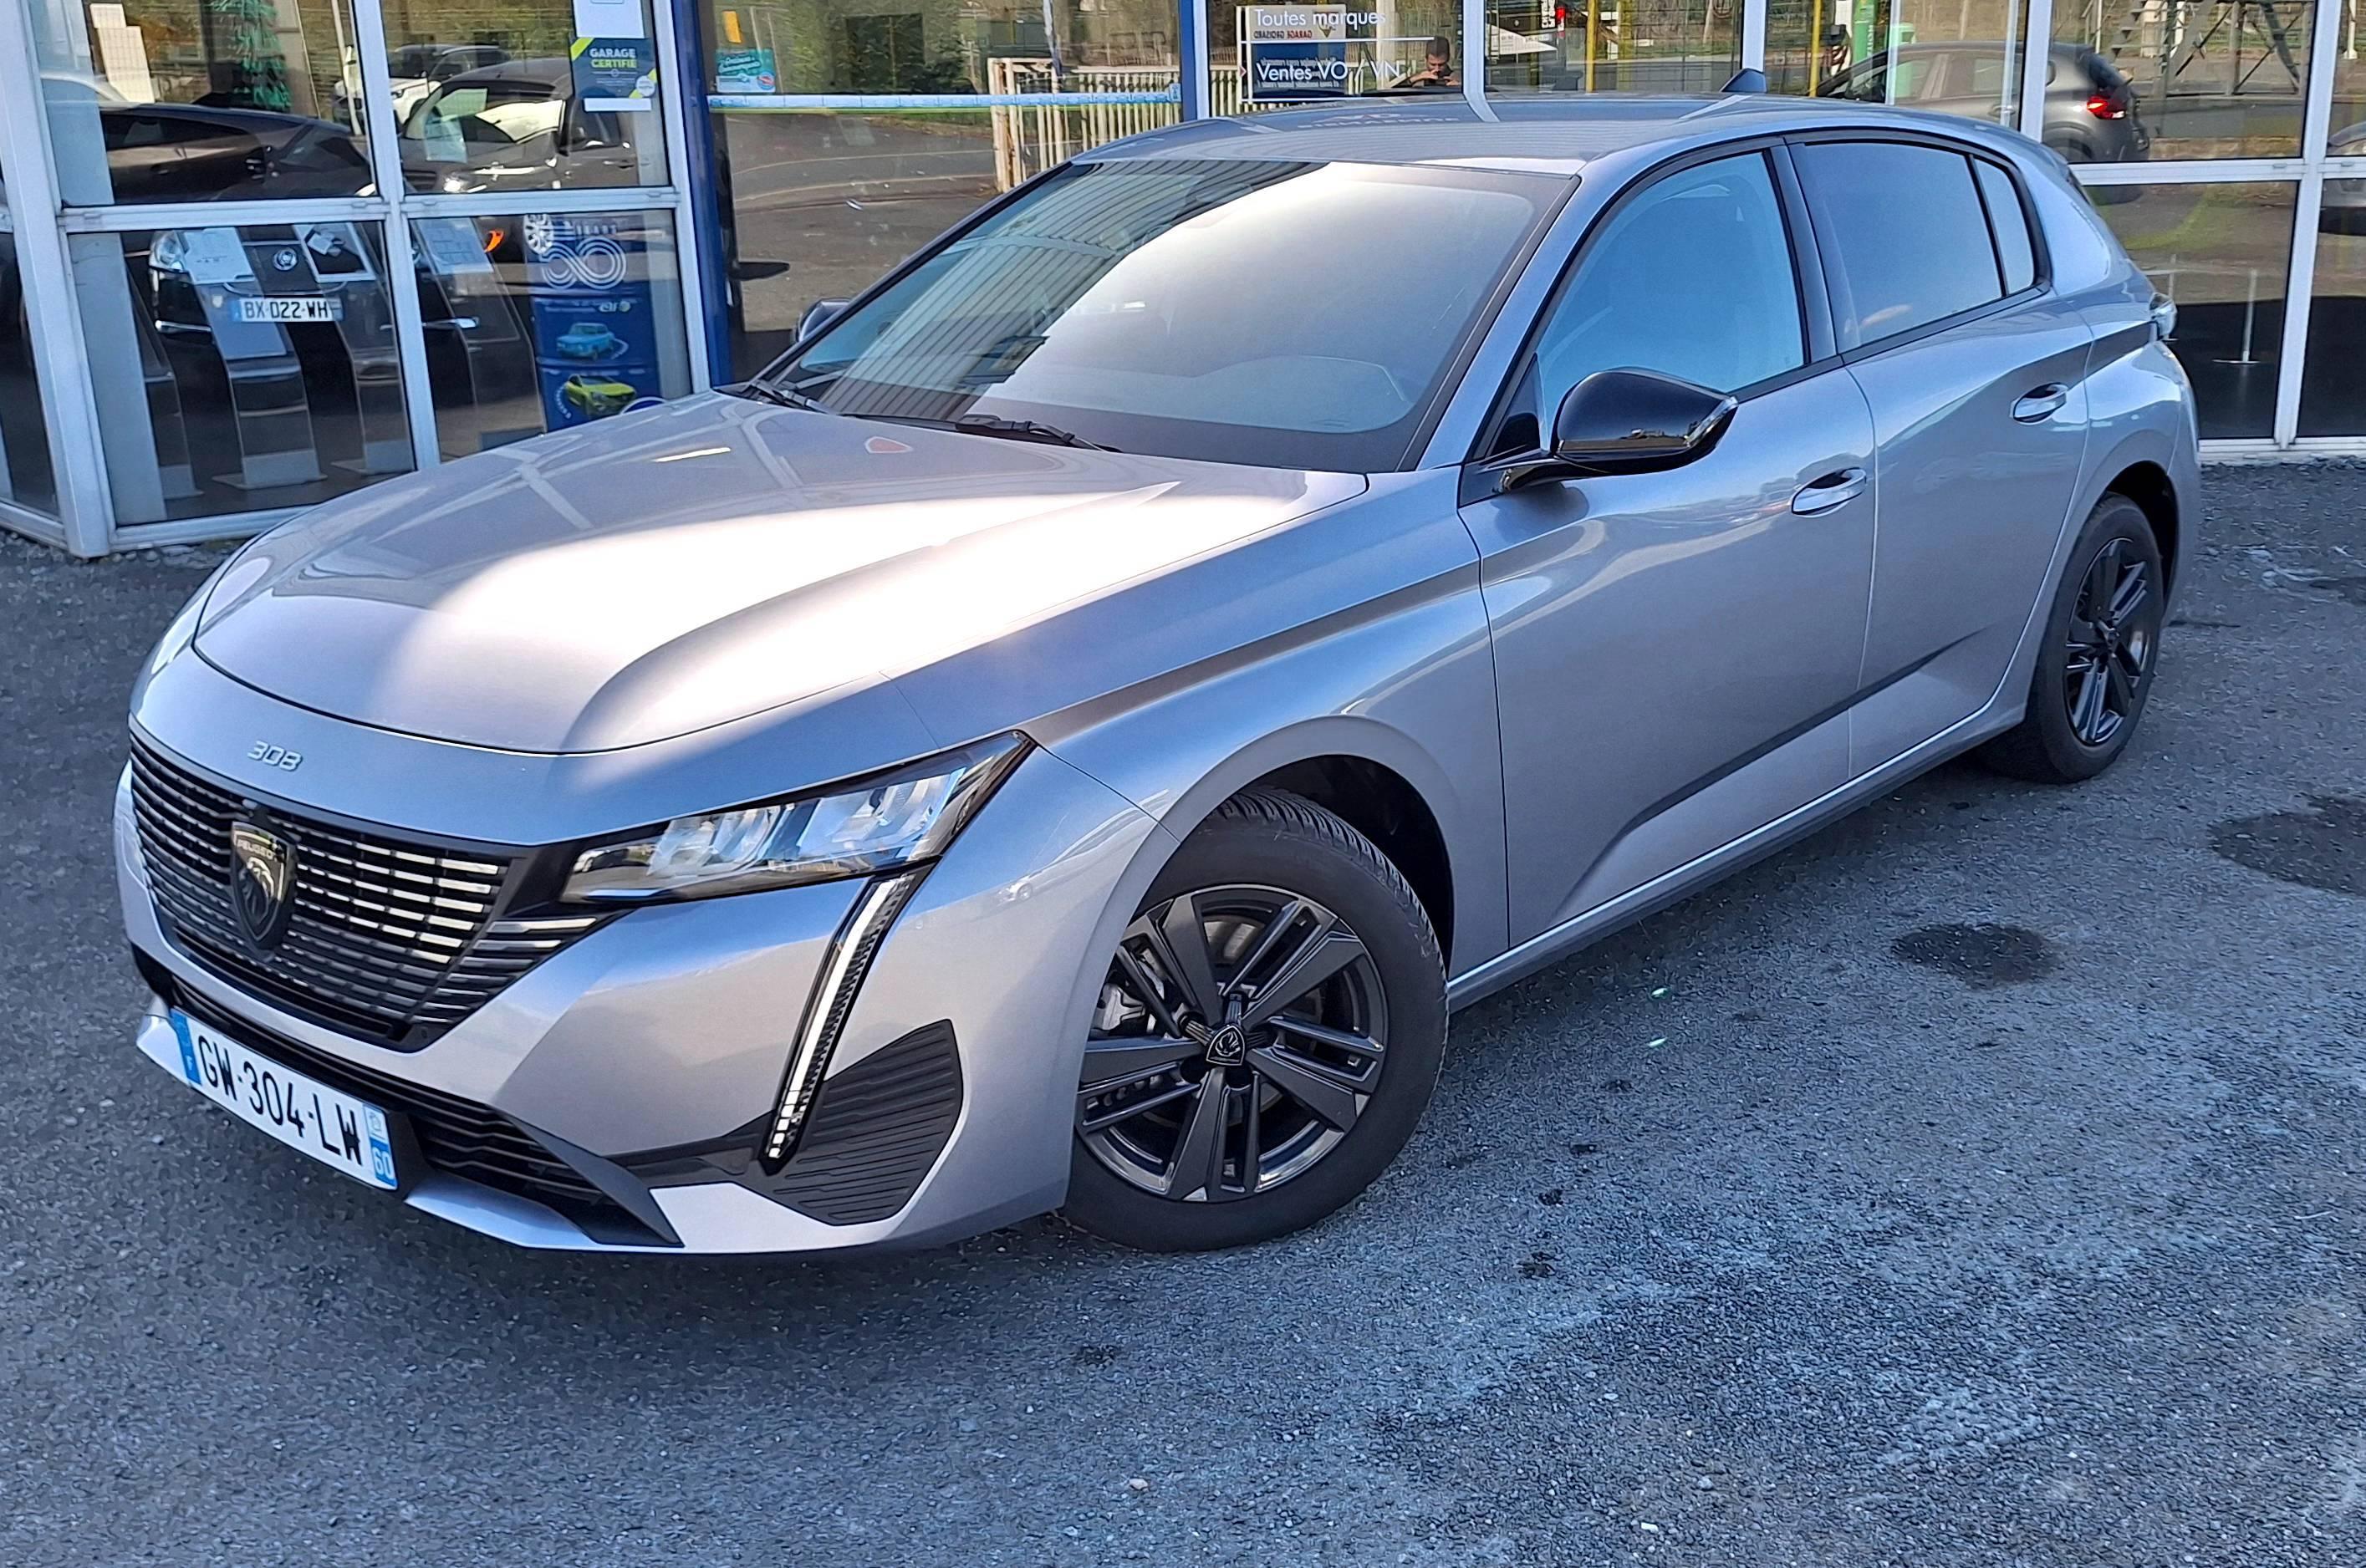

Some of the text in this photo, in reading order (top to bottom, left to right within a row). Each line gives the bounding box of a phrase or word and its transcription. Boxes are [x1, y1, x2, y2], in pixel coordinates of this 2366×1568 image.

[1255, 8, 1386, 31] Toutes marques
[589, 48, 636, 59] GARAGE
[1257, 62, 1313, 81] Ventes
[1318, 61, 1349, 80] VO
[247, 741, 303, 771] 308
[186, 1035, 395, 1180] F GW-304-LW 60
